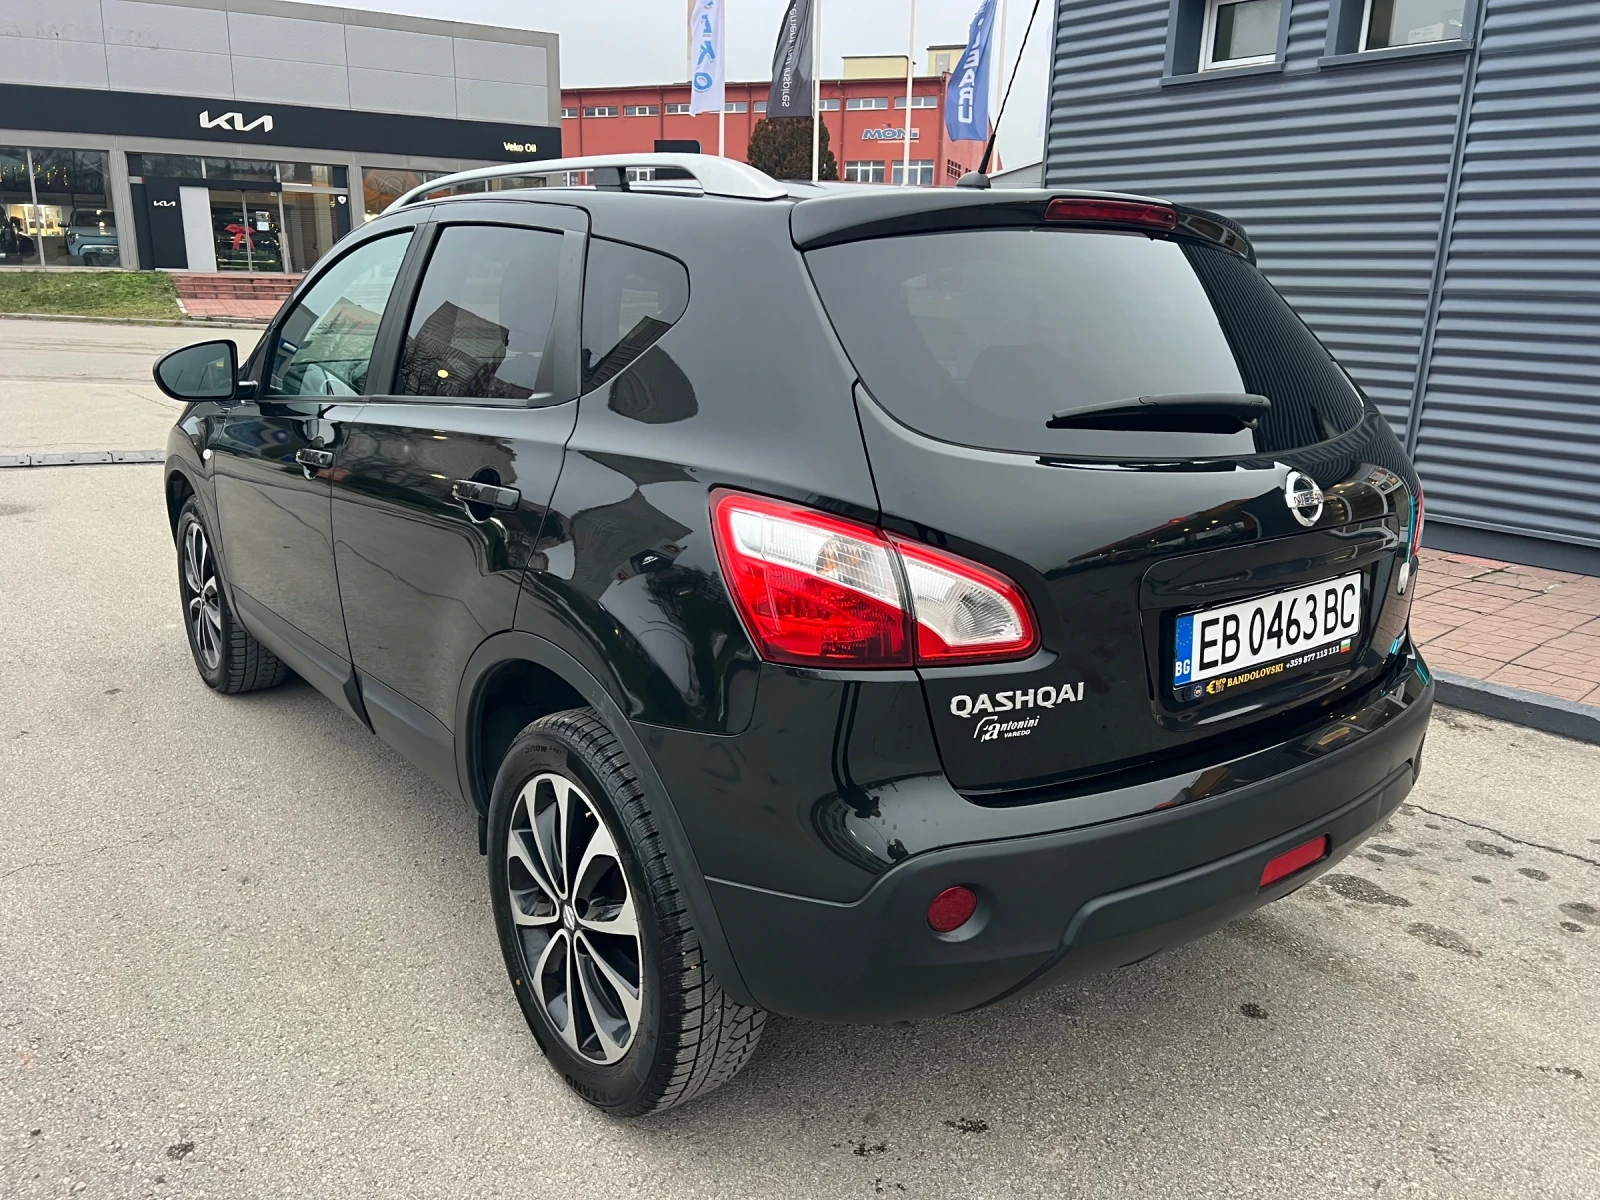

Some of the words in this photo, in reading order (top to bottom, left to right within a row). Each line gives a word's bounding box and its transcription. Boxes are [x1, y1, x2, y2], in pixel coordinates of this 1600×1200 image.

[199, 110, 273, 133] KIA
[503, 141, 524, 152] Veko
[525, 143, 537, 153] Oil
[1199, 613, 1241, 671] EB
[1249, 593, 1317, 656] 0463
[1324, 583, 1356, 636] BC
[1175, 659, 1191, 677] BG
[1227, 663, 1285, 687] BANDOLOVSKI
[1286, 657, 1303, 669] +359
[1303, 653, 1316, 665] 877
[1316, 649, 1328, 660] 113
[1328, 645, 1340, 657] 111
[950, 681, 1085, 718] QASHQAI
[1004, 729, 1031, 739] VAREDO
